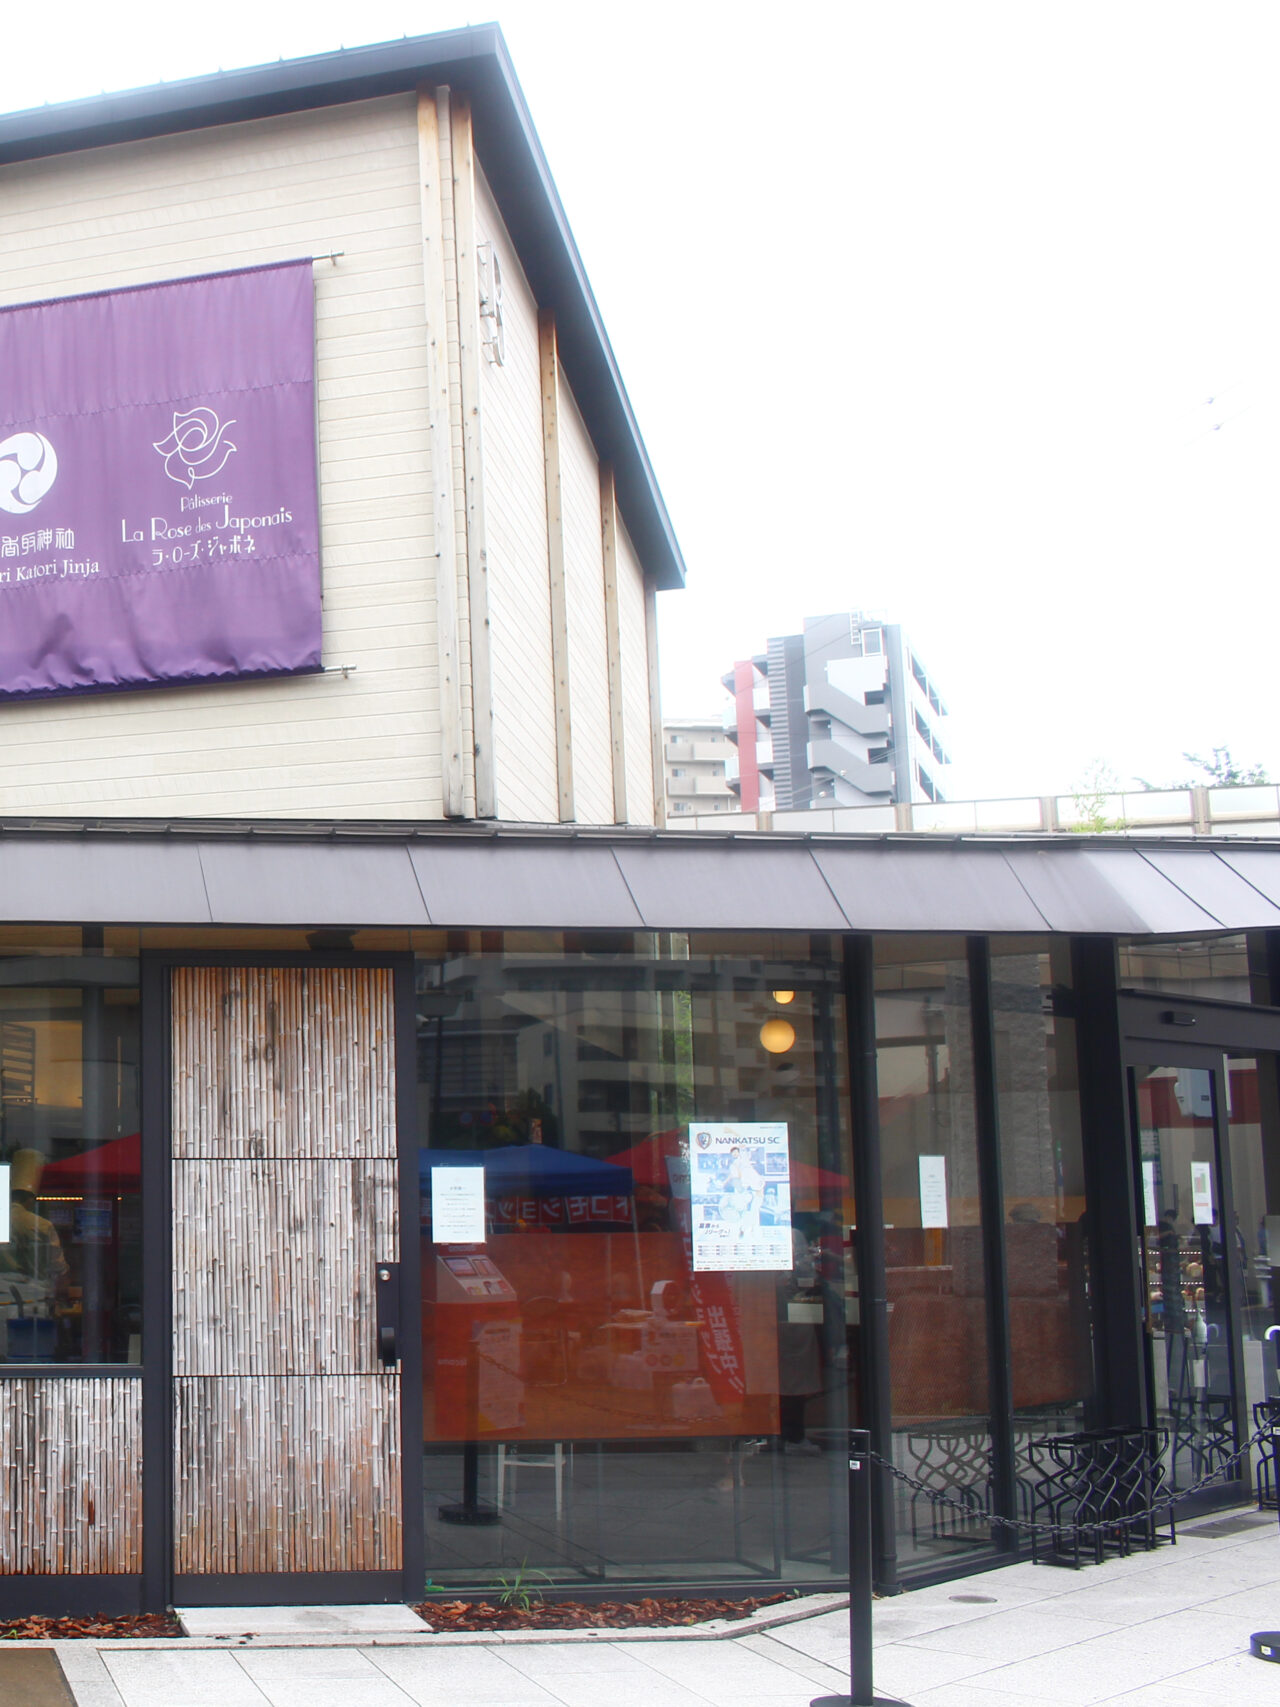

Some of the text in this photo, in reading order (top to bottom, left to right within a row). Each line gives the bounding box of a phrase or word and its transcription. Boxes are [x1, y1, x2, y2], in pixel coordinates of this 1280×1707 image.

[122, 504, 293, 542] La Rose des Japonais
[16, 559, 58, 582] Katori
[60, 558, 100, 578] Jinja
[715, 1137, 765, 1145] NANKATSU
